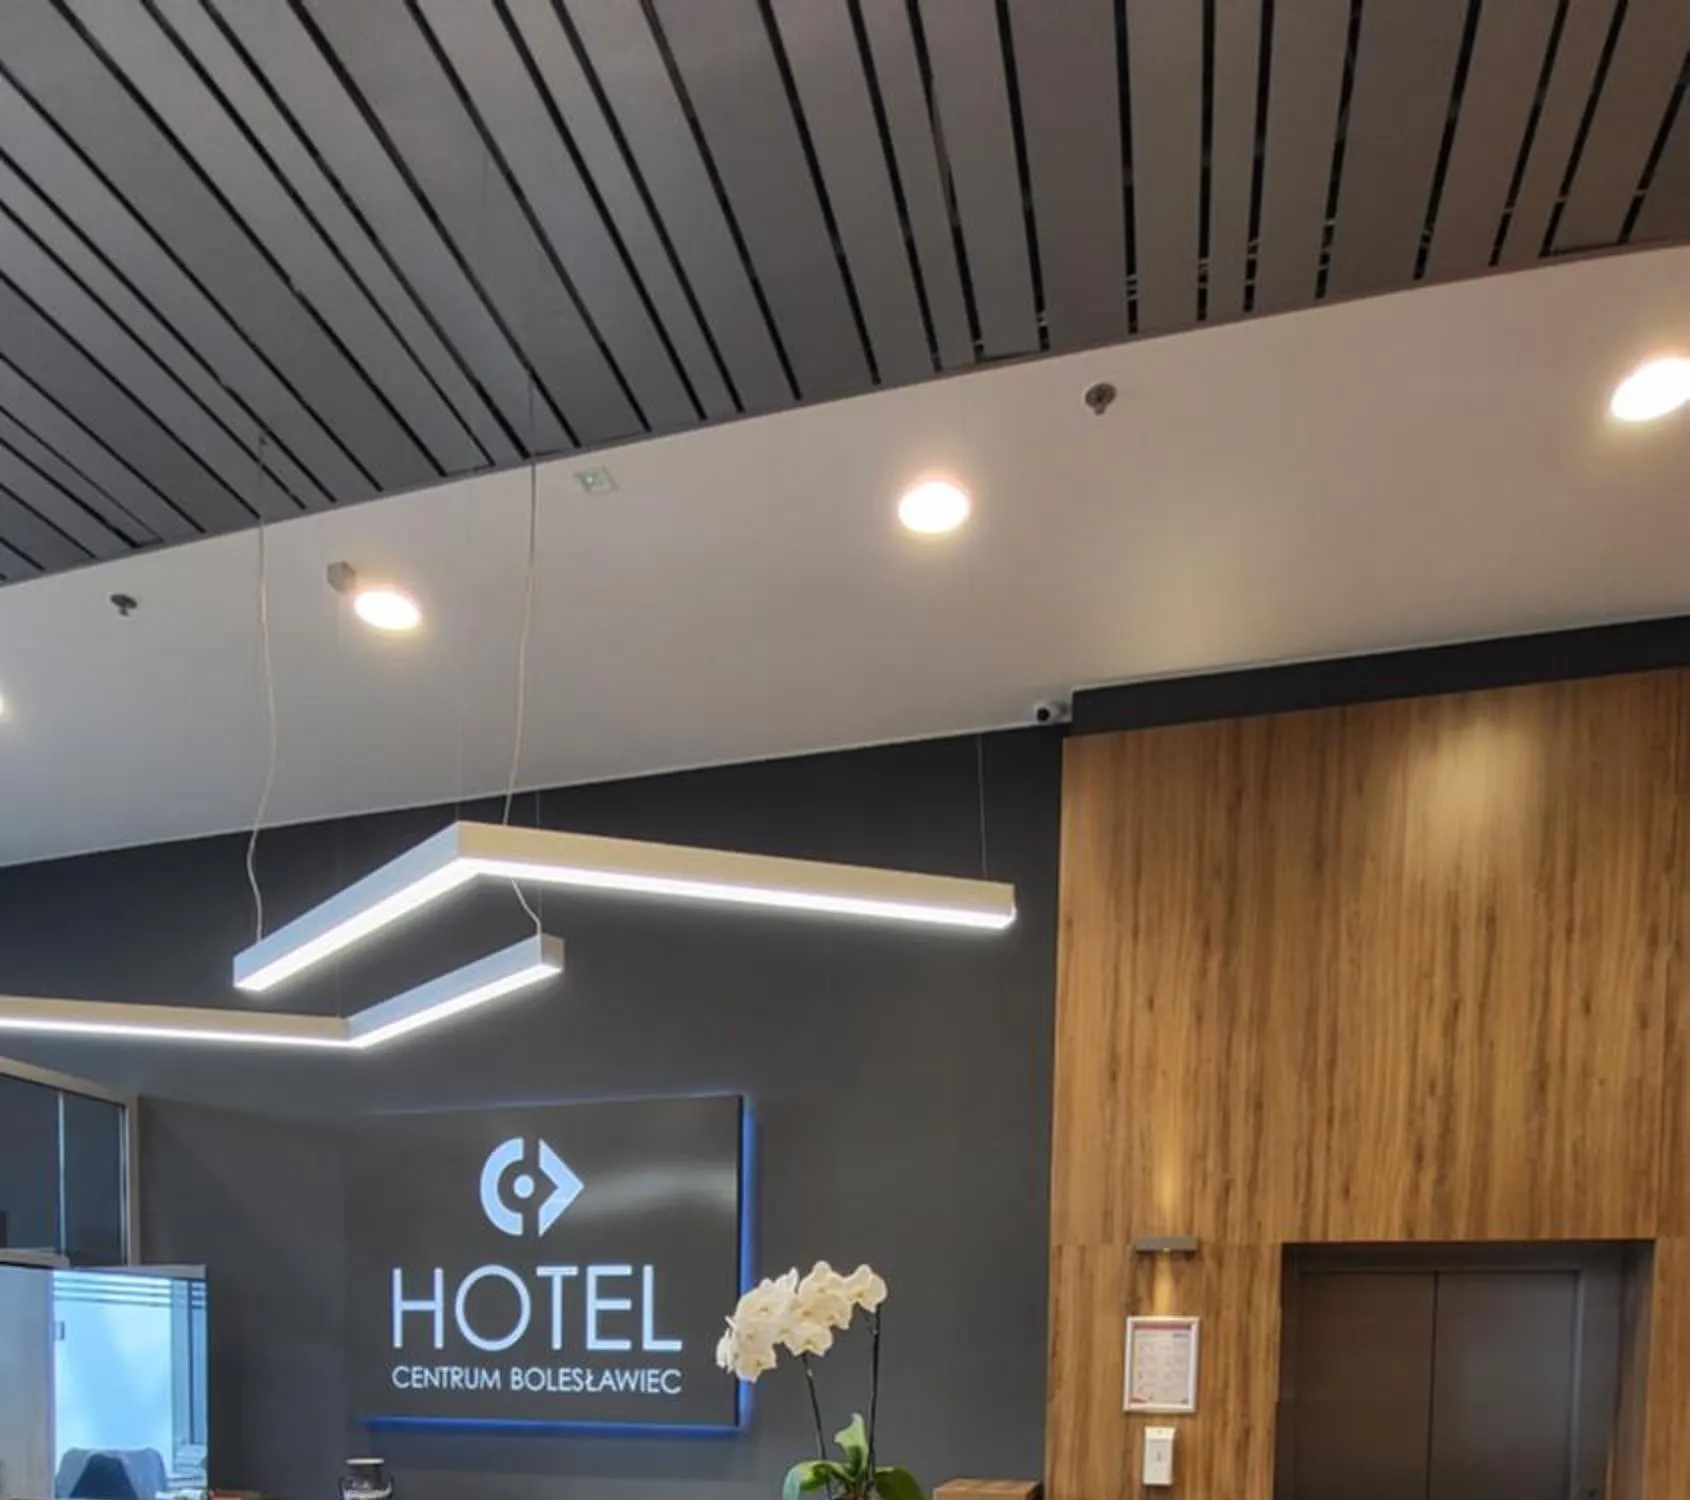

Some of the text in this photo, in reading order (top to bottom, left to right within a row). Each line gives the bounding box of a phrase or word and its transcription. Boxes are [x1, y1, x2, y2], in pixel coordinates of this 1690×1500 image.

[392, 1264, 683, 1352] HOTEL
[391, 1365, 682, 1394] CENTRUM BOLESŁAWIEC
